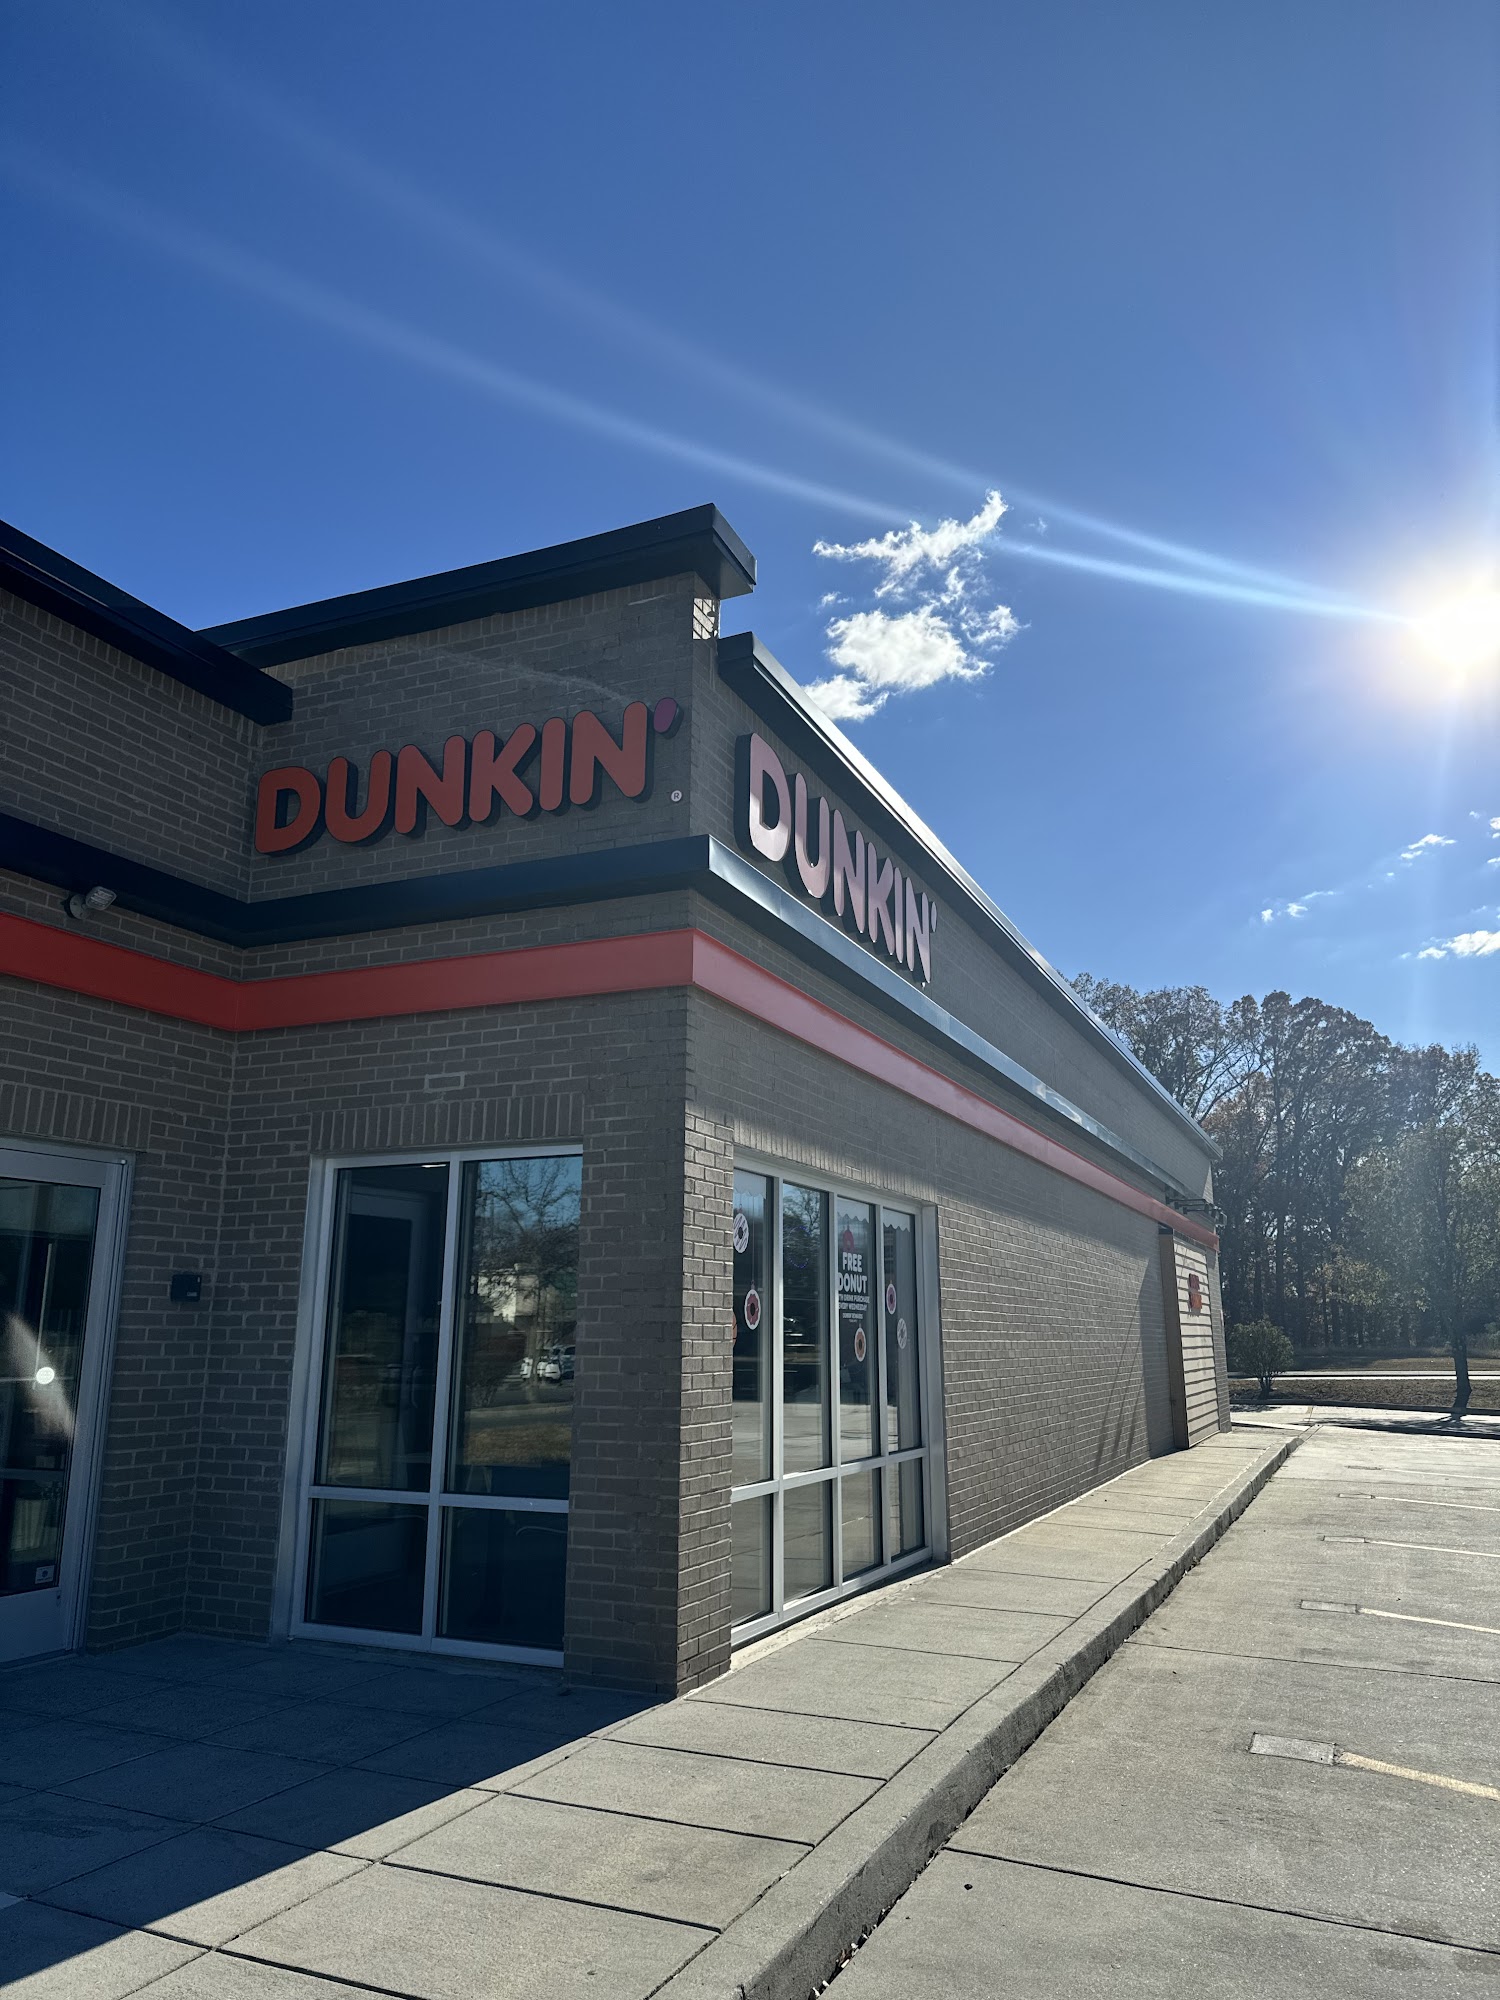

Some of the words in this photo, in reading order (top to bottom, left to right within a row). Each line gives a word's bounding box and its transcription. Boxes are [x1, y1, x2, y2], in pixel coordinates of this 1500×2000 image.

[255, 697, 681, 855] DUNKIN'
[749, 732, 937, 984] DUNKIN'
[837, 1272, 868, 1294] DONUT
[842, 1251, 862, 1273] FREE
